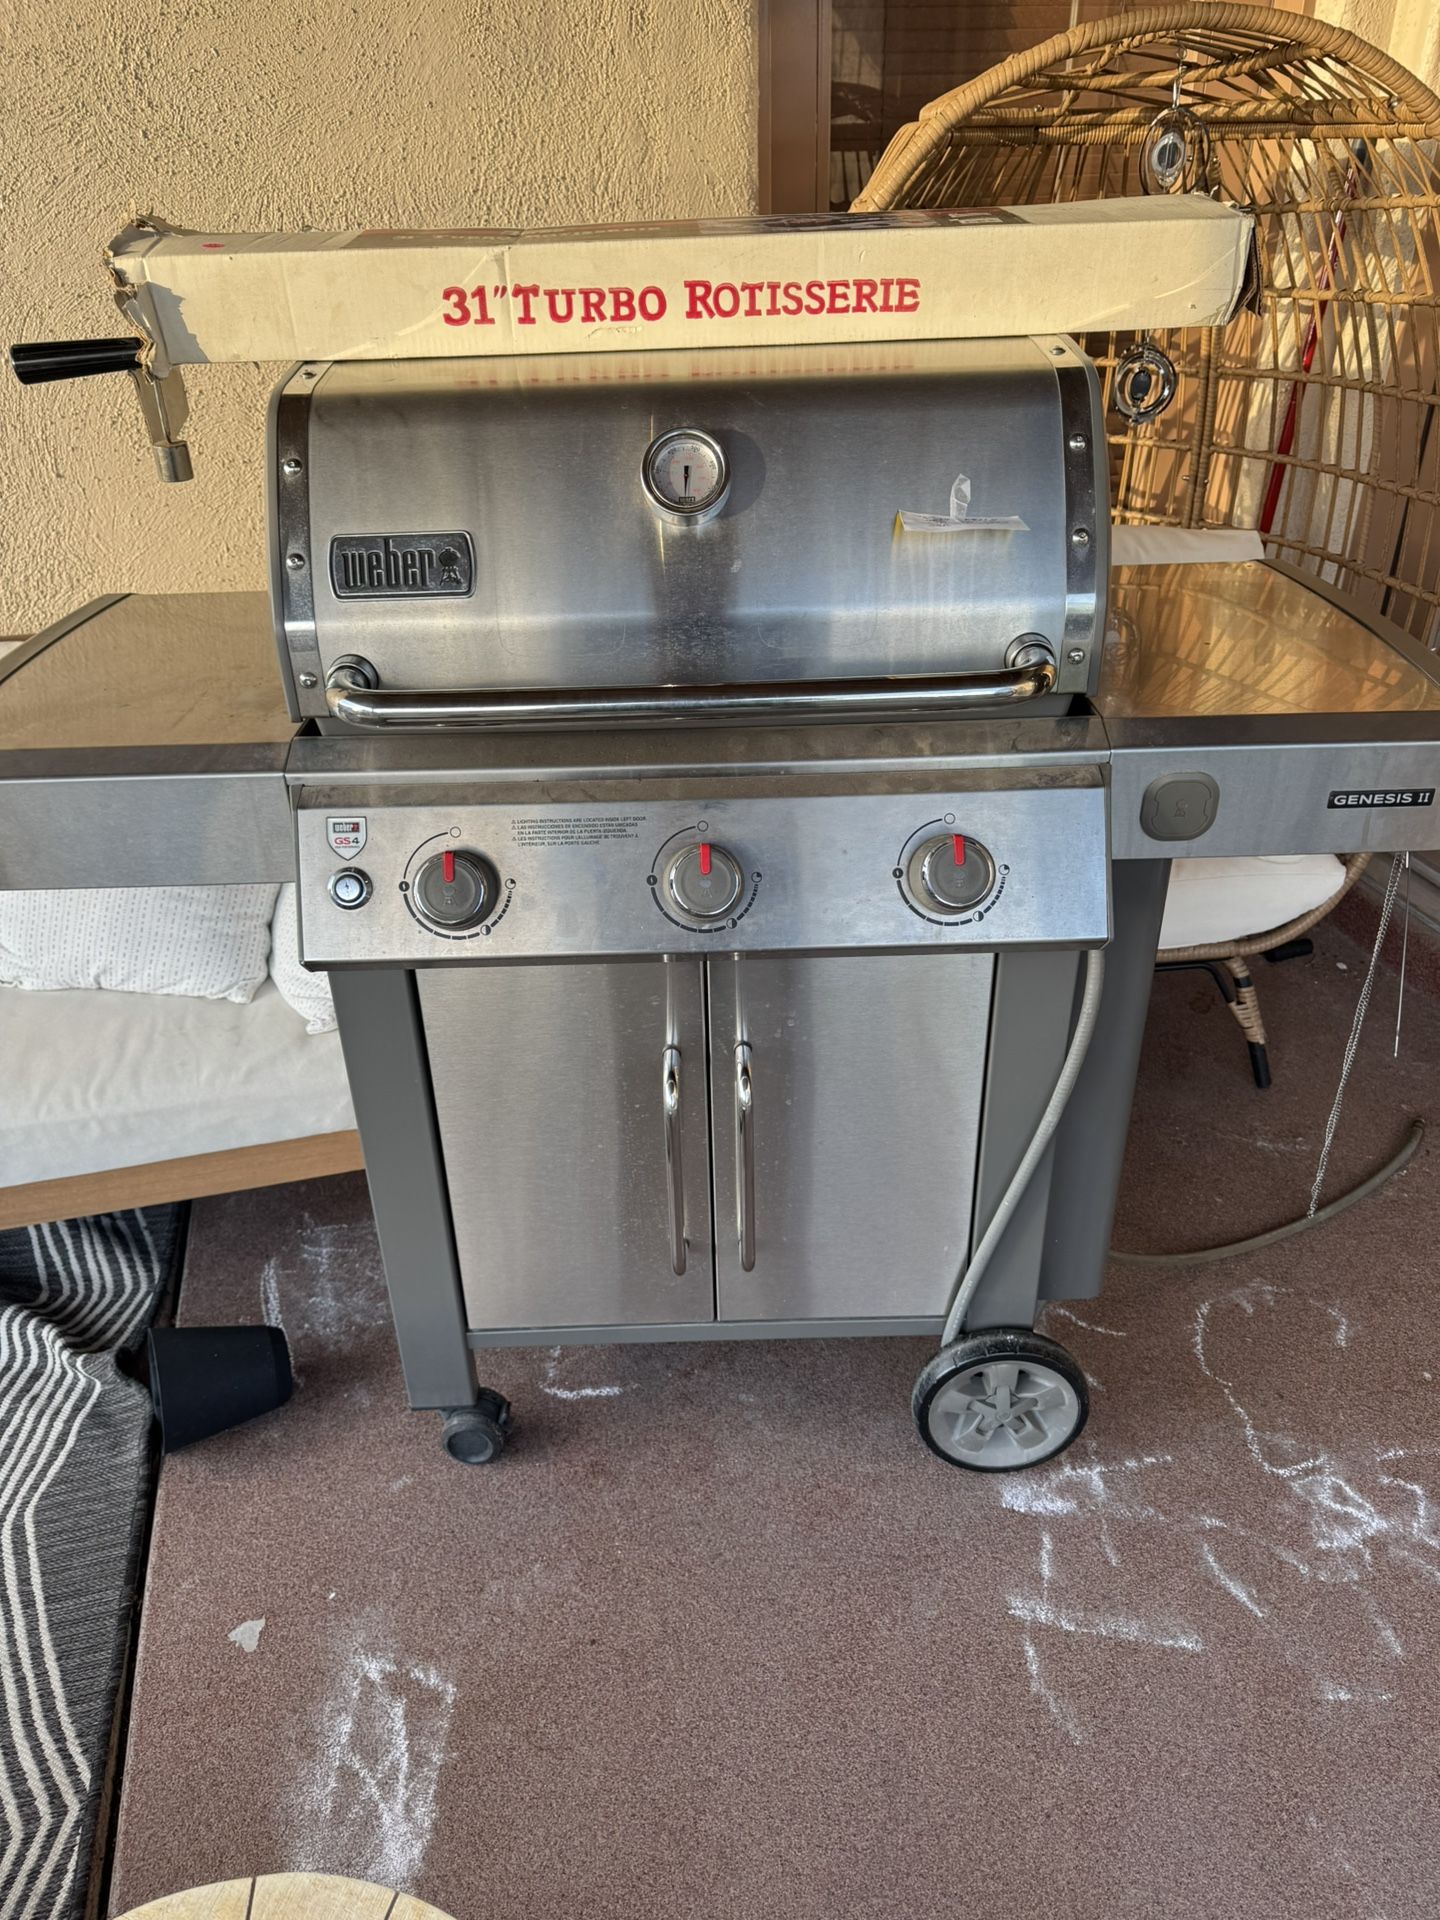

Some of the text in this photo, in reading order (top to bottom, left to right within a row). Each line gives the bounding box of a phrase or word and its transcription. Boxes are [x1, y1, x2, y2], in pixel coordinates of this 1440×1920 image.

[684, 278, 920, 320] ROTISSERIE
[341, 538, 437, 588] weber
[1334, 793, 1430, 805] GENESIS II
